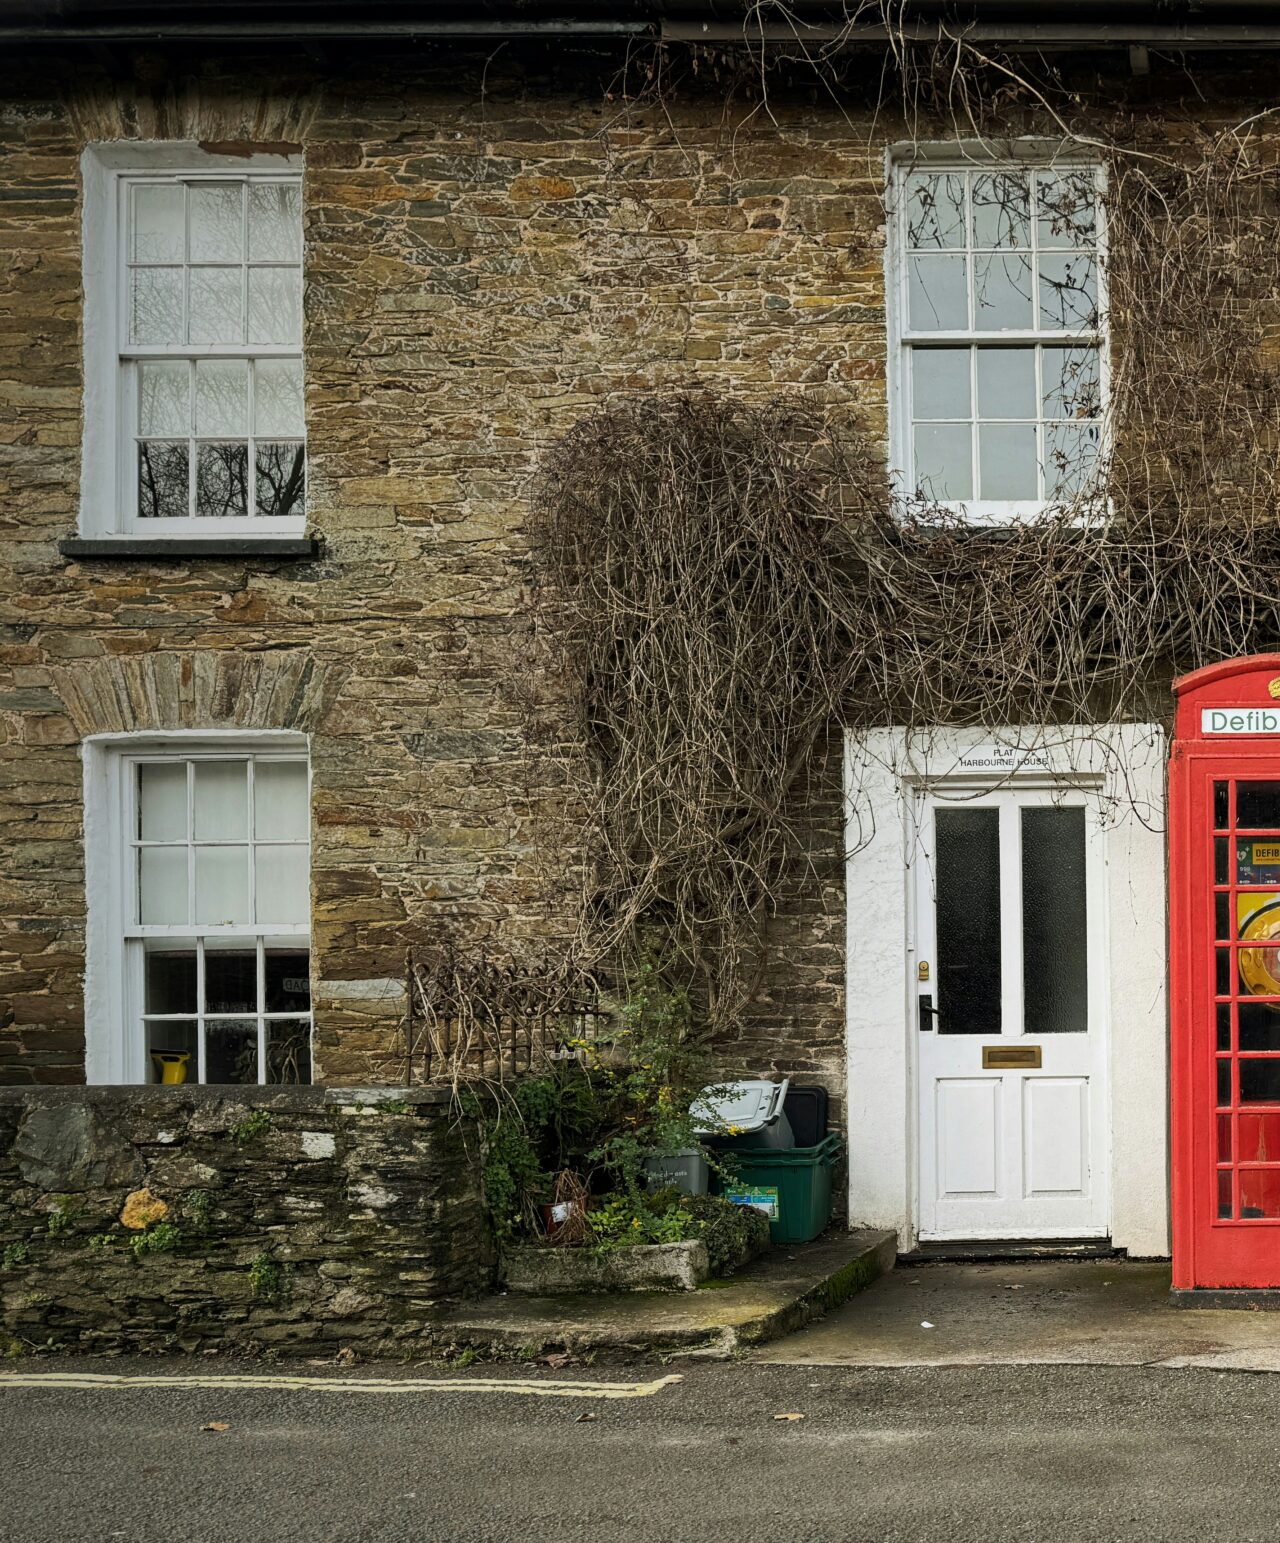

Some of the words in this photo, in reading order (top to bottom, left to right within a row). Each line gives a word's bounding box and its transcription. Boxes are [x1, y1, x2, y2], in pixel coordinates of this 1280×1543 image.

[993, 749, 1014, 757] FLAT
[960, 758, 1014, 767] HARBOURNE
[1017, 757, 1049, 766] HOUSE
